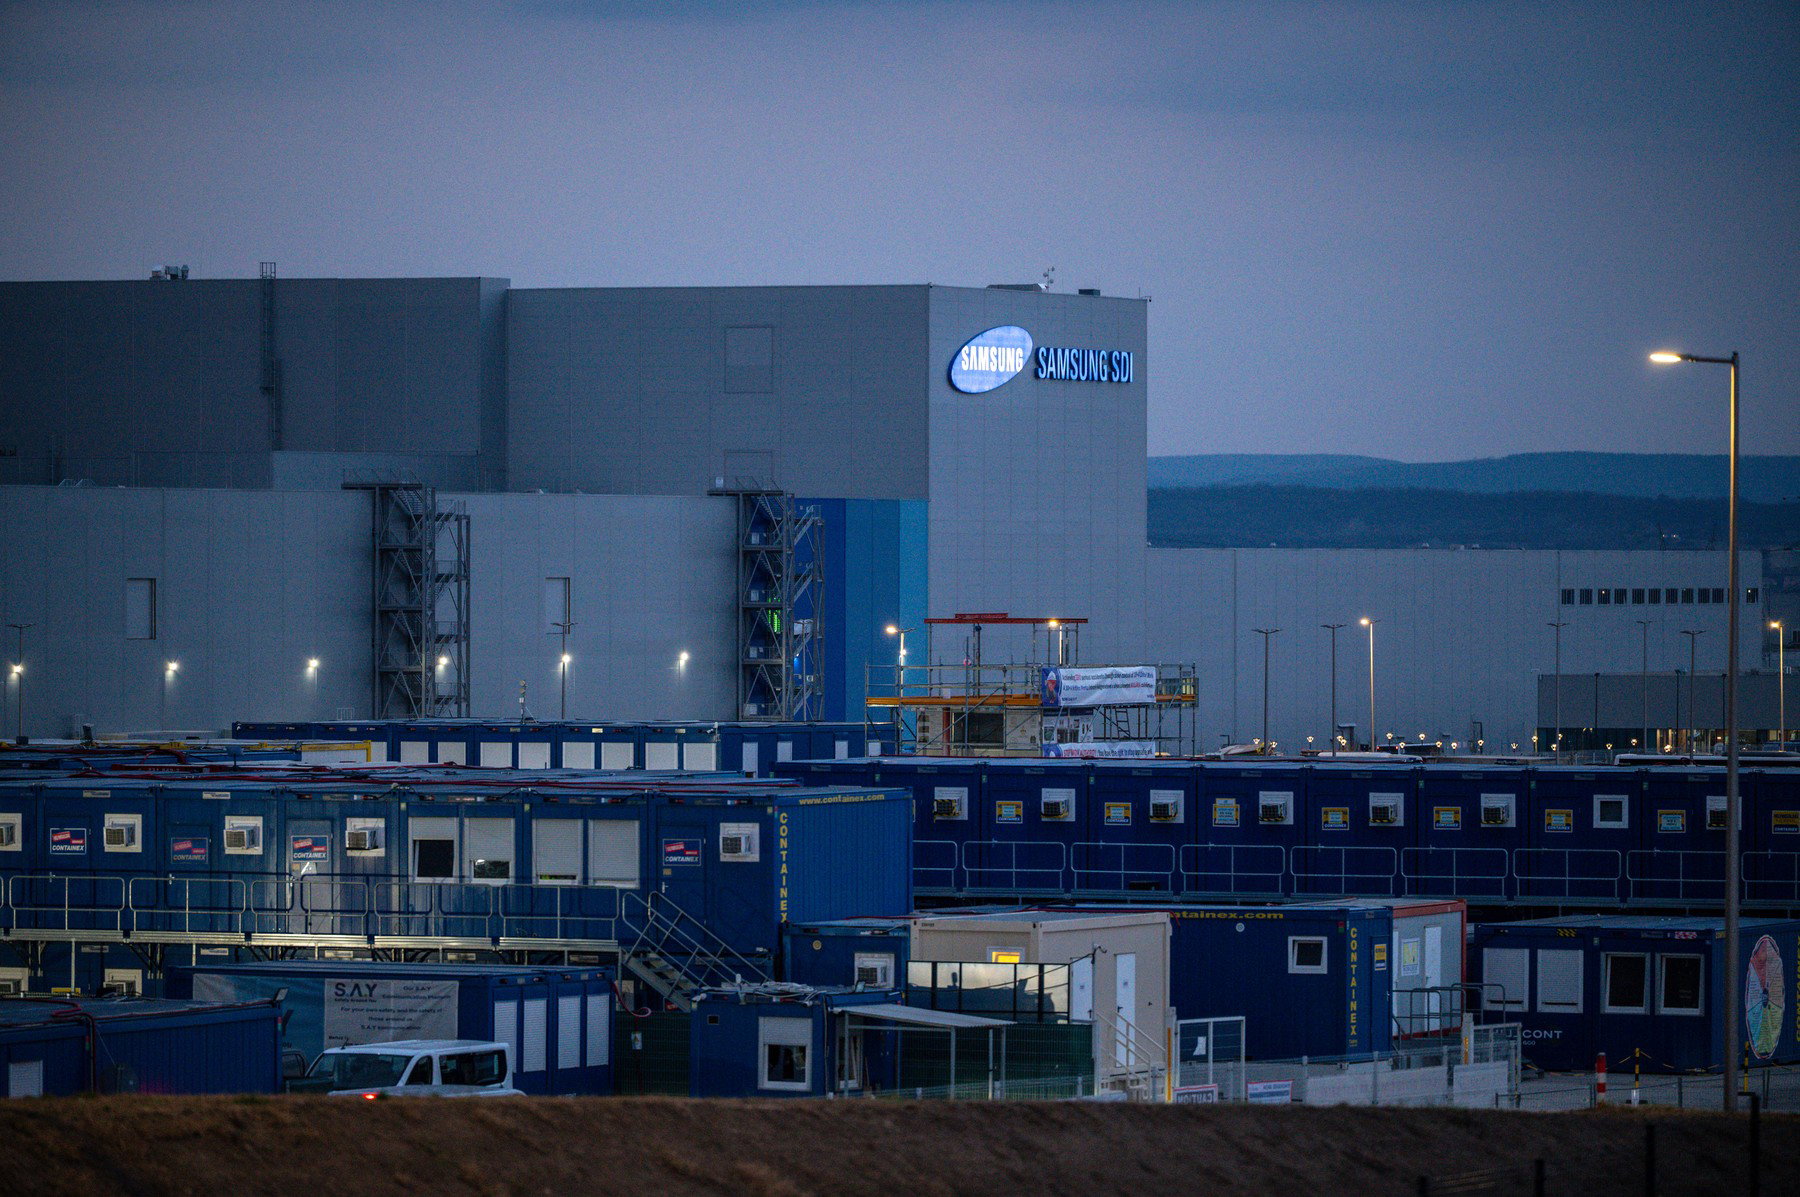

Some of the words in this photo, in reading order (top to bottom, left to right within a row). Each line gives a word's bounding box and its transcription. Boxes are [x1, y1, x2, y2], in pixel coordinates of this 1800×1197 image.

[961, 345, 1023, 373] SAMSUNG
[1036, 347, 1109, 382] SAMSUNG
[1110, 350, 1133, 383] SDI
[799, 794, 885, 806] www.containex.com
[665, 855, 699, 863] CONTAINEX
[780, 812, 788, 923] CONTAINEX
[1170, 910, 1284, 919] ntainex.com
[1350, 928, 1358, 1036] CONTAINEX
